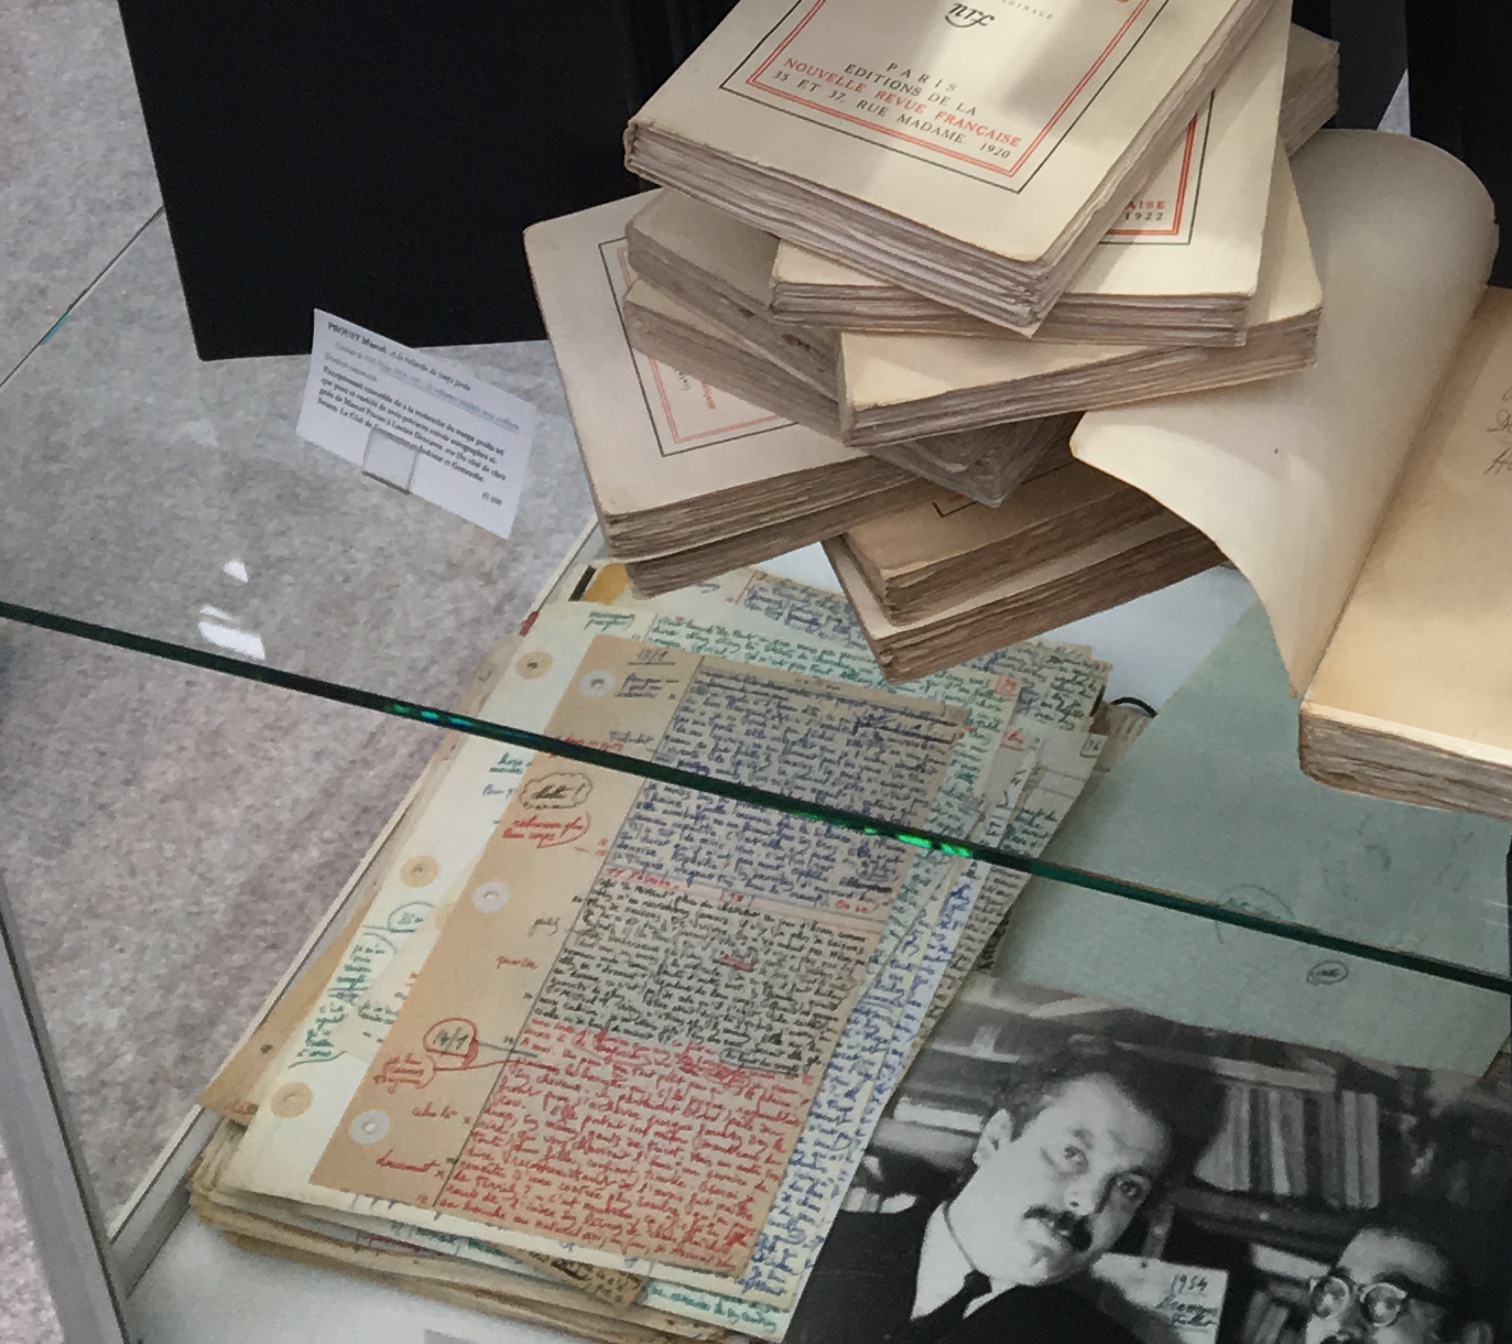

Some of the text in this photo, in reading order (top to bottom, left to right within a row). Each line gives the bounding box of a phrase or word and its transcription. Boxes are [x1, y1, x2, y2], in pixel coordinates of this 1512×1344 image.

[783, 57, 1023, 149] NOUVELLE REVUE FRANÇAISE
[843, 63, 977, 117] EDITIONS DE LA
[886, 62, 959, 93] PARIS
[772, 69, 790, 82] 35
[797, 79, 821, 93] ET
[856, 99, 894, 118] RUE
[979, 141, 1012, 160] 1920
